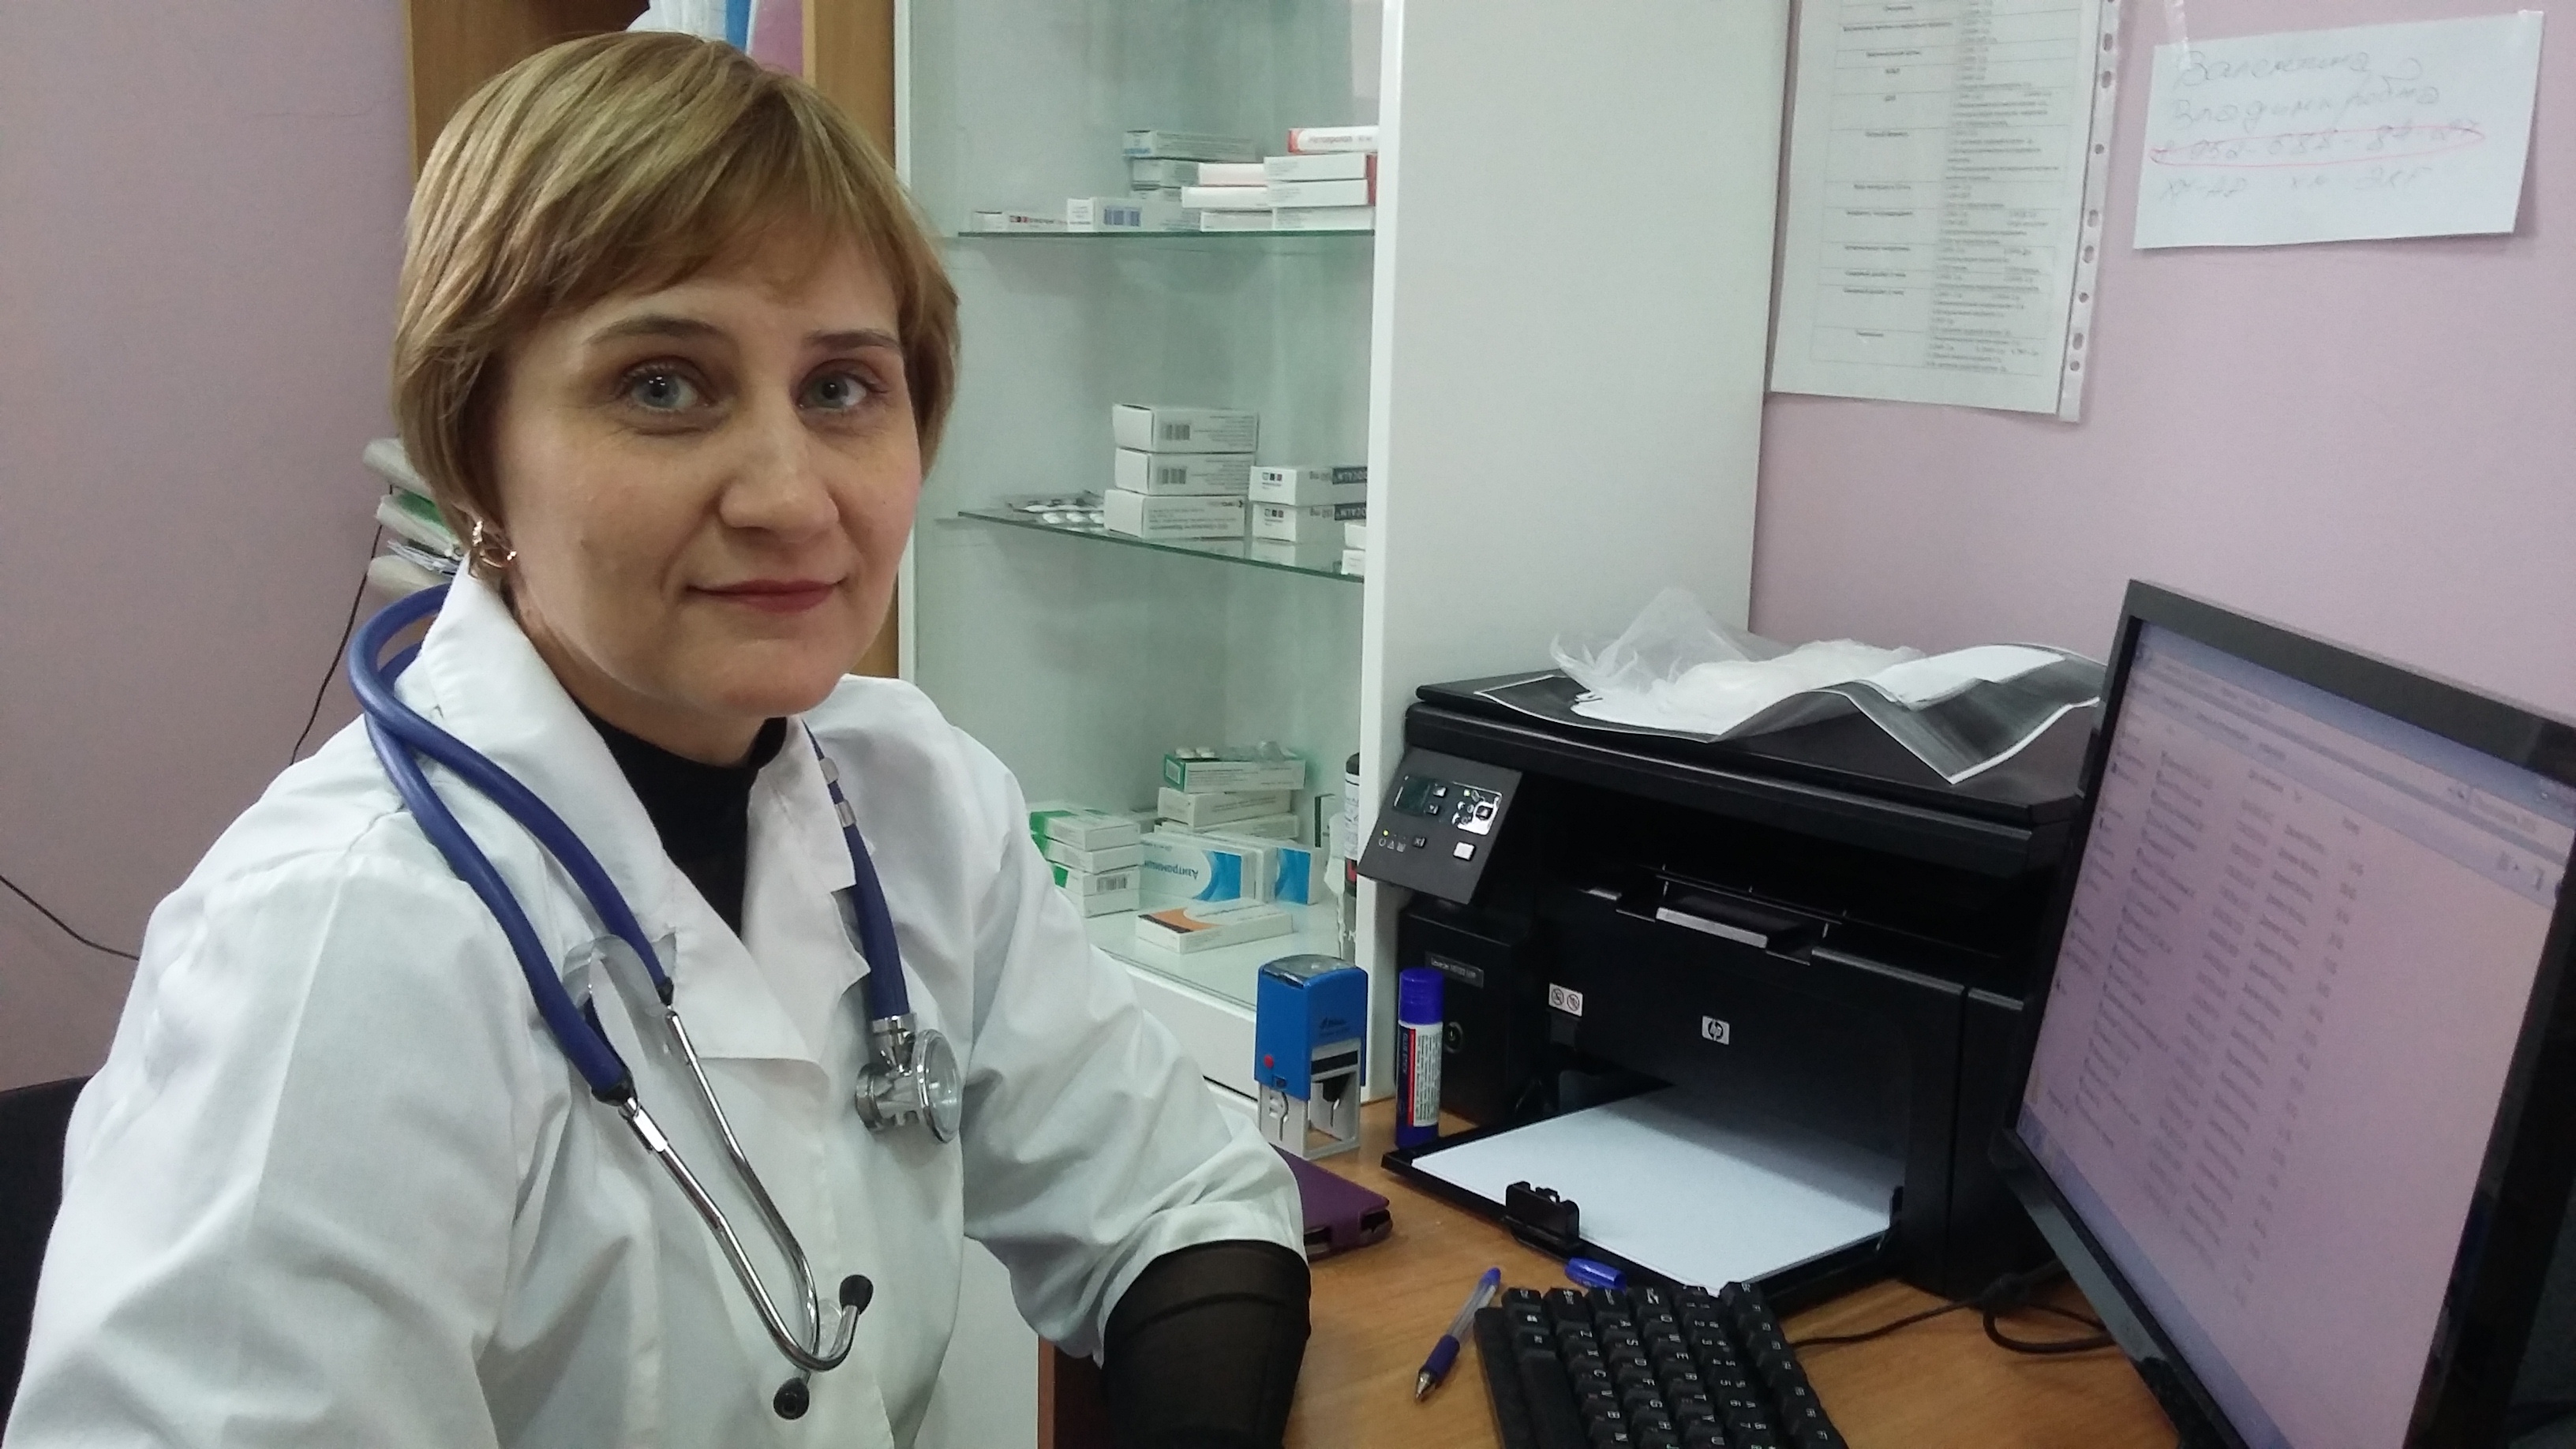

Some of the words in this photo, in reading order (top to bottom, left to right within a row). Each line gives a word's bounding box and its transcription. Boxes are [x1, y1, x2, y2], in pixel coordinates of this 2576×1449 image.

[1619, 1319, 1631, 1327] A
[1627, 1338, 1639, 1346] S
[1634, 1357, 1647, 1366] D
[1593, 1368, 1607, 1378] C
[1601, 1389, 1614, 1398] V
[1649, 1398, 1663, 1408] G
[1607, 1410, 1620, 1419] B
[1658, 1421, 1672, 1430] H
[1614, 1432, 1628, 1442] N
[1711, 1436, 1725, 1445] U
